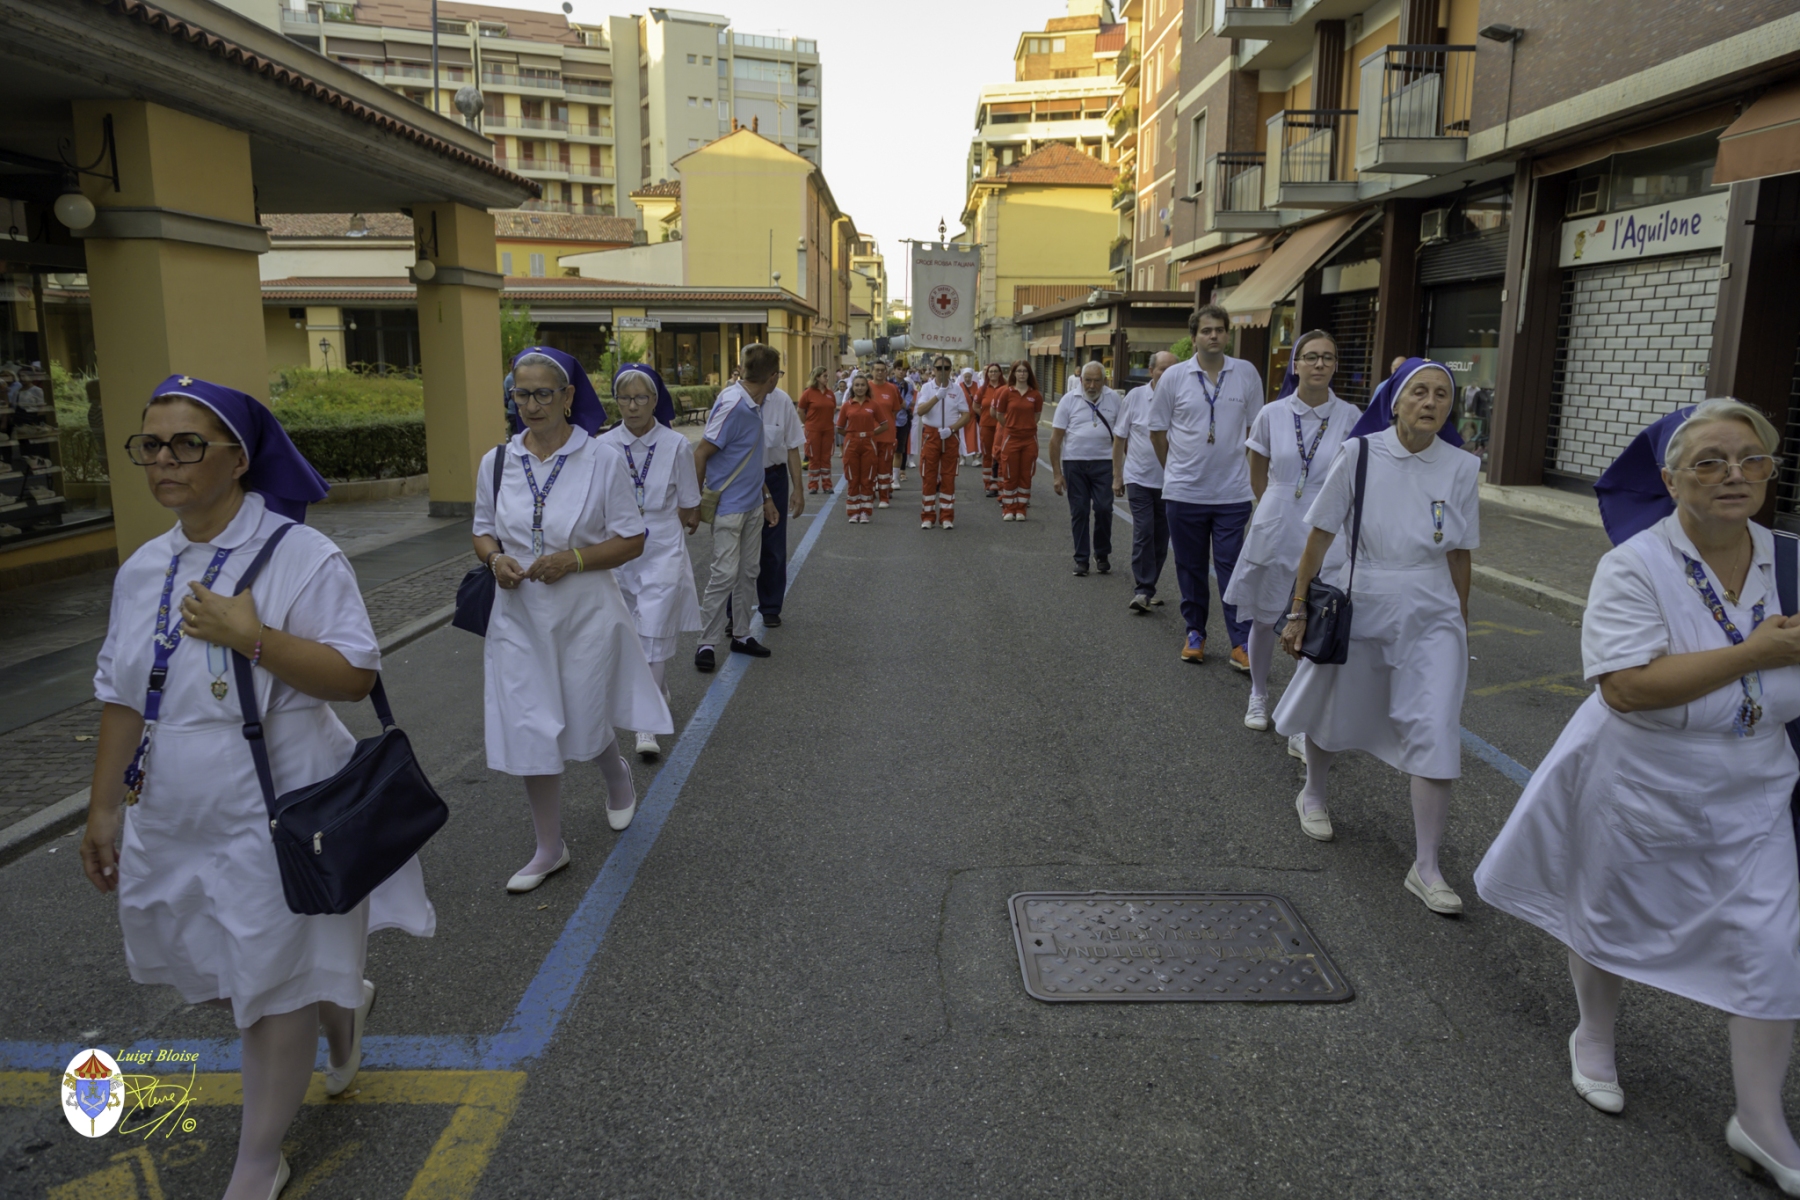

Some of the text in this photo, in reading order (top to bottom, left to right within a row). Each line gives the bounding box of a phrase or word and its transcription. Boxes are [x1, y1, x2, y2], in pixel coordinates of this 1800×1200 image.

[1612, 210, 1702, 255] l'Aquilone
[953, 260, 975, 268] ITALIANA
[921, 333, 963, 343] TORTONA
